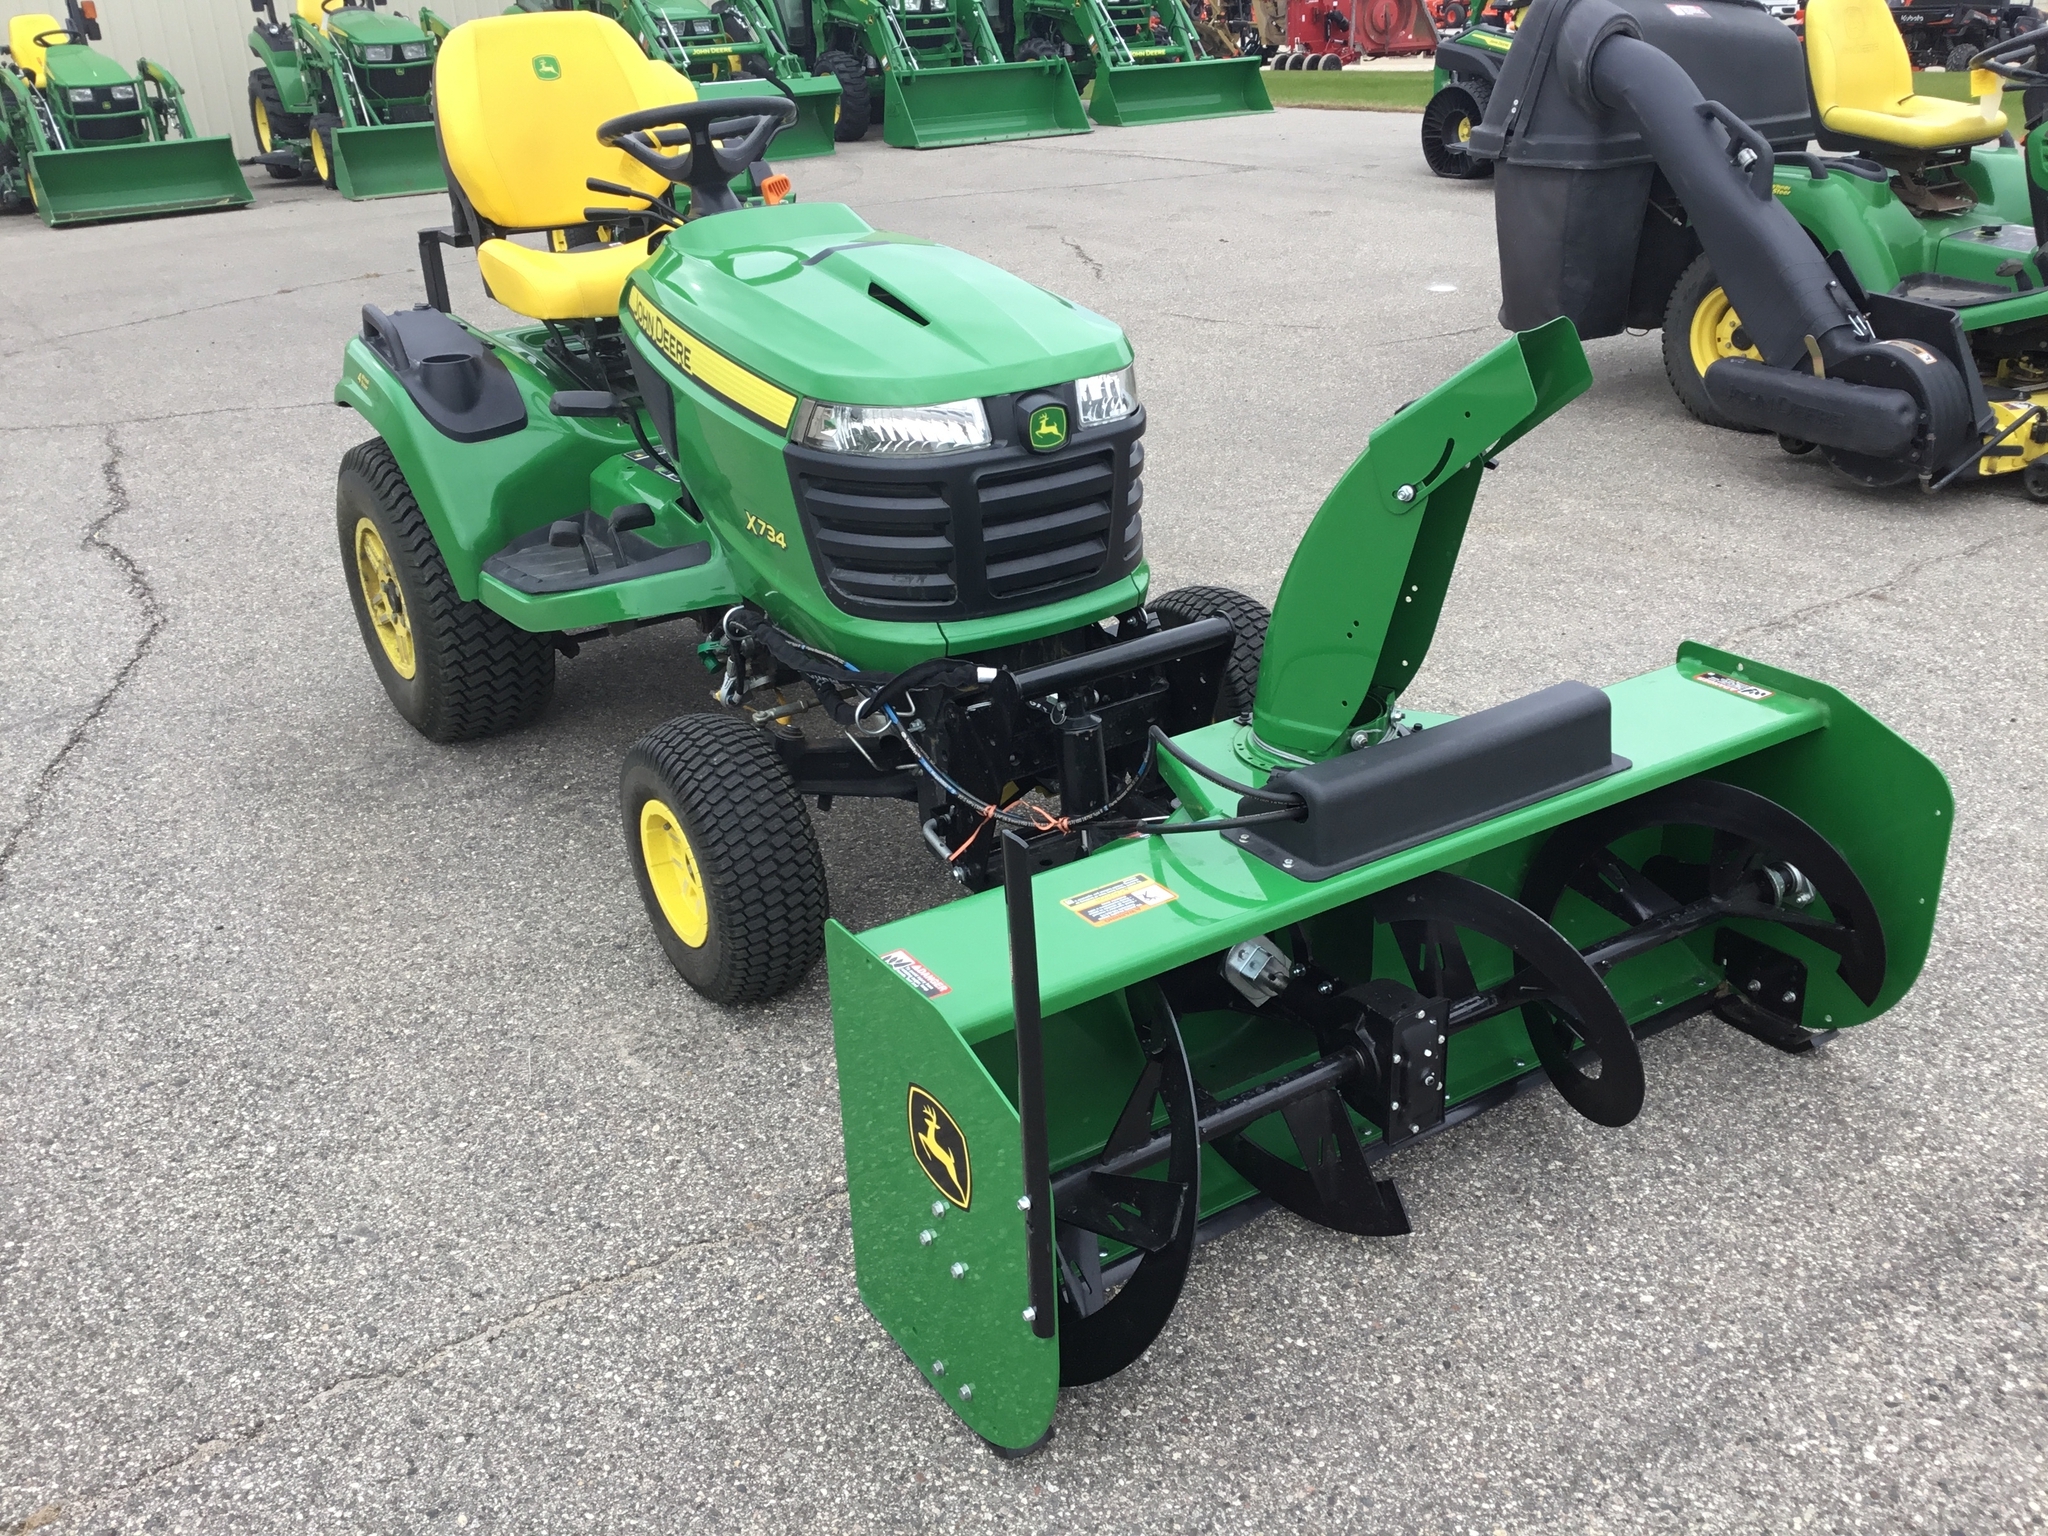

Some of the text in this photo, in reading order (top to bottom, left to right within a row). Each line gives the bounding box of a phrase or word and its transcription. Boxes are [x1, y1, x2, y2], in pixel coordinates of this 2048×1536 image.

[1900, 14, 1924, 22] Kubota
[1145, 49, 1166, 57] DEERE
[634, 292, 692, 371] JOHN DEERE
[744, 510, 787, 549] X734
[918, 967, 949, 992] DANGER
